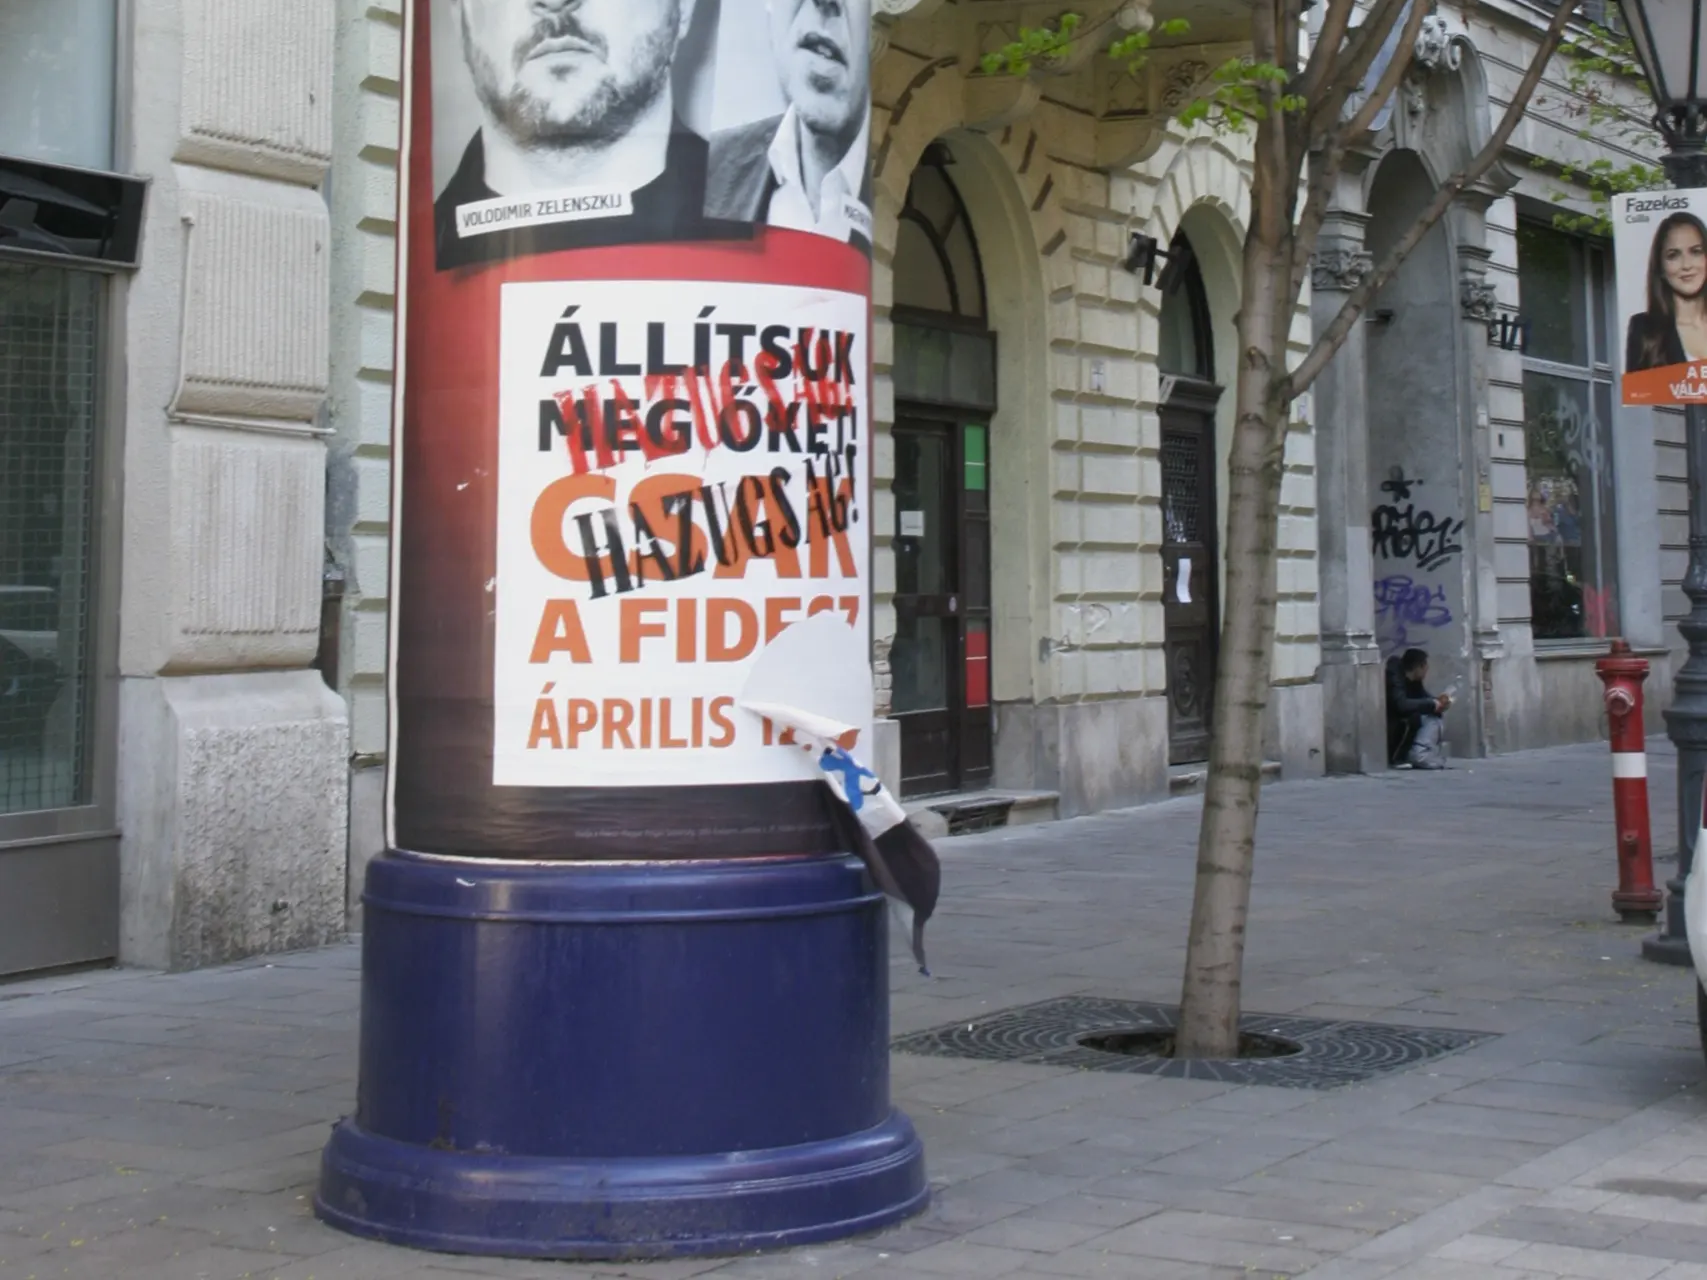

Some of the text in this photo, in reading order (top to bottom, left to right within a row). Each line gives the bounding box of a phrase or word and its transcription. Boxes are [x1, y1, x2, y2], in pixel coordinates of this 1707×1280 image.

[462, 194, 623, 228] VOLODIMIR ZELENSZKIJ
[1625, 195, 1689, 212] Fazekas
[539, 305, 855, 385] ÁLLÍTSUK
[1686, 366, 1698, 375] A
[538, 387, 856, 453] MEG ŐKET!
[530, 474, 858, 580] CSAK
[529, 599, 592, 664] A
[527, 682, 735, 750] ÁPRILIS
